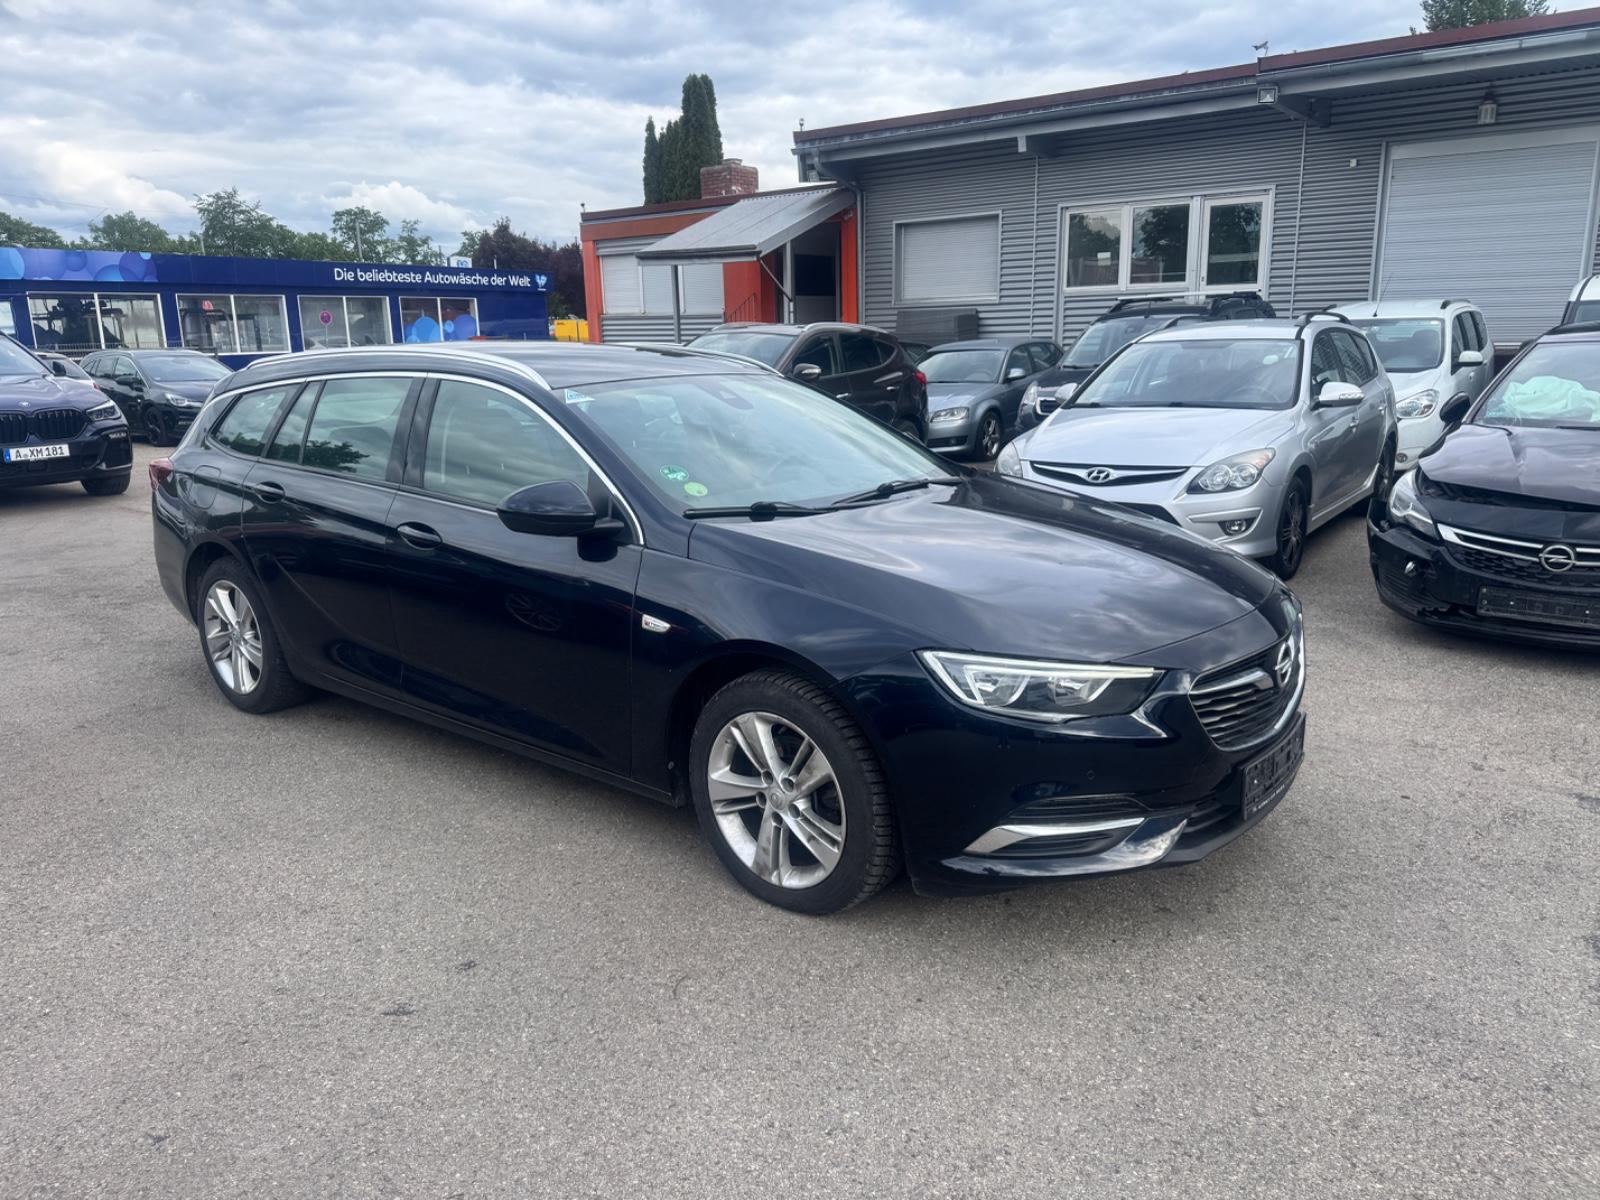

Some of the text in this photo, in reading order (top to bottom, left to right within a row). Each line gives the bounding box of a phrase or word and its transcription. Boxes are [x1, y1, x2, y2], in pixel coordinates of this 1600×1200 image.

[334, 267, 531, 287] Die beliebteste Autowäsche der Welt
[15, 449, 22, 459] A
